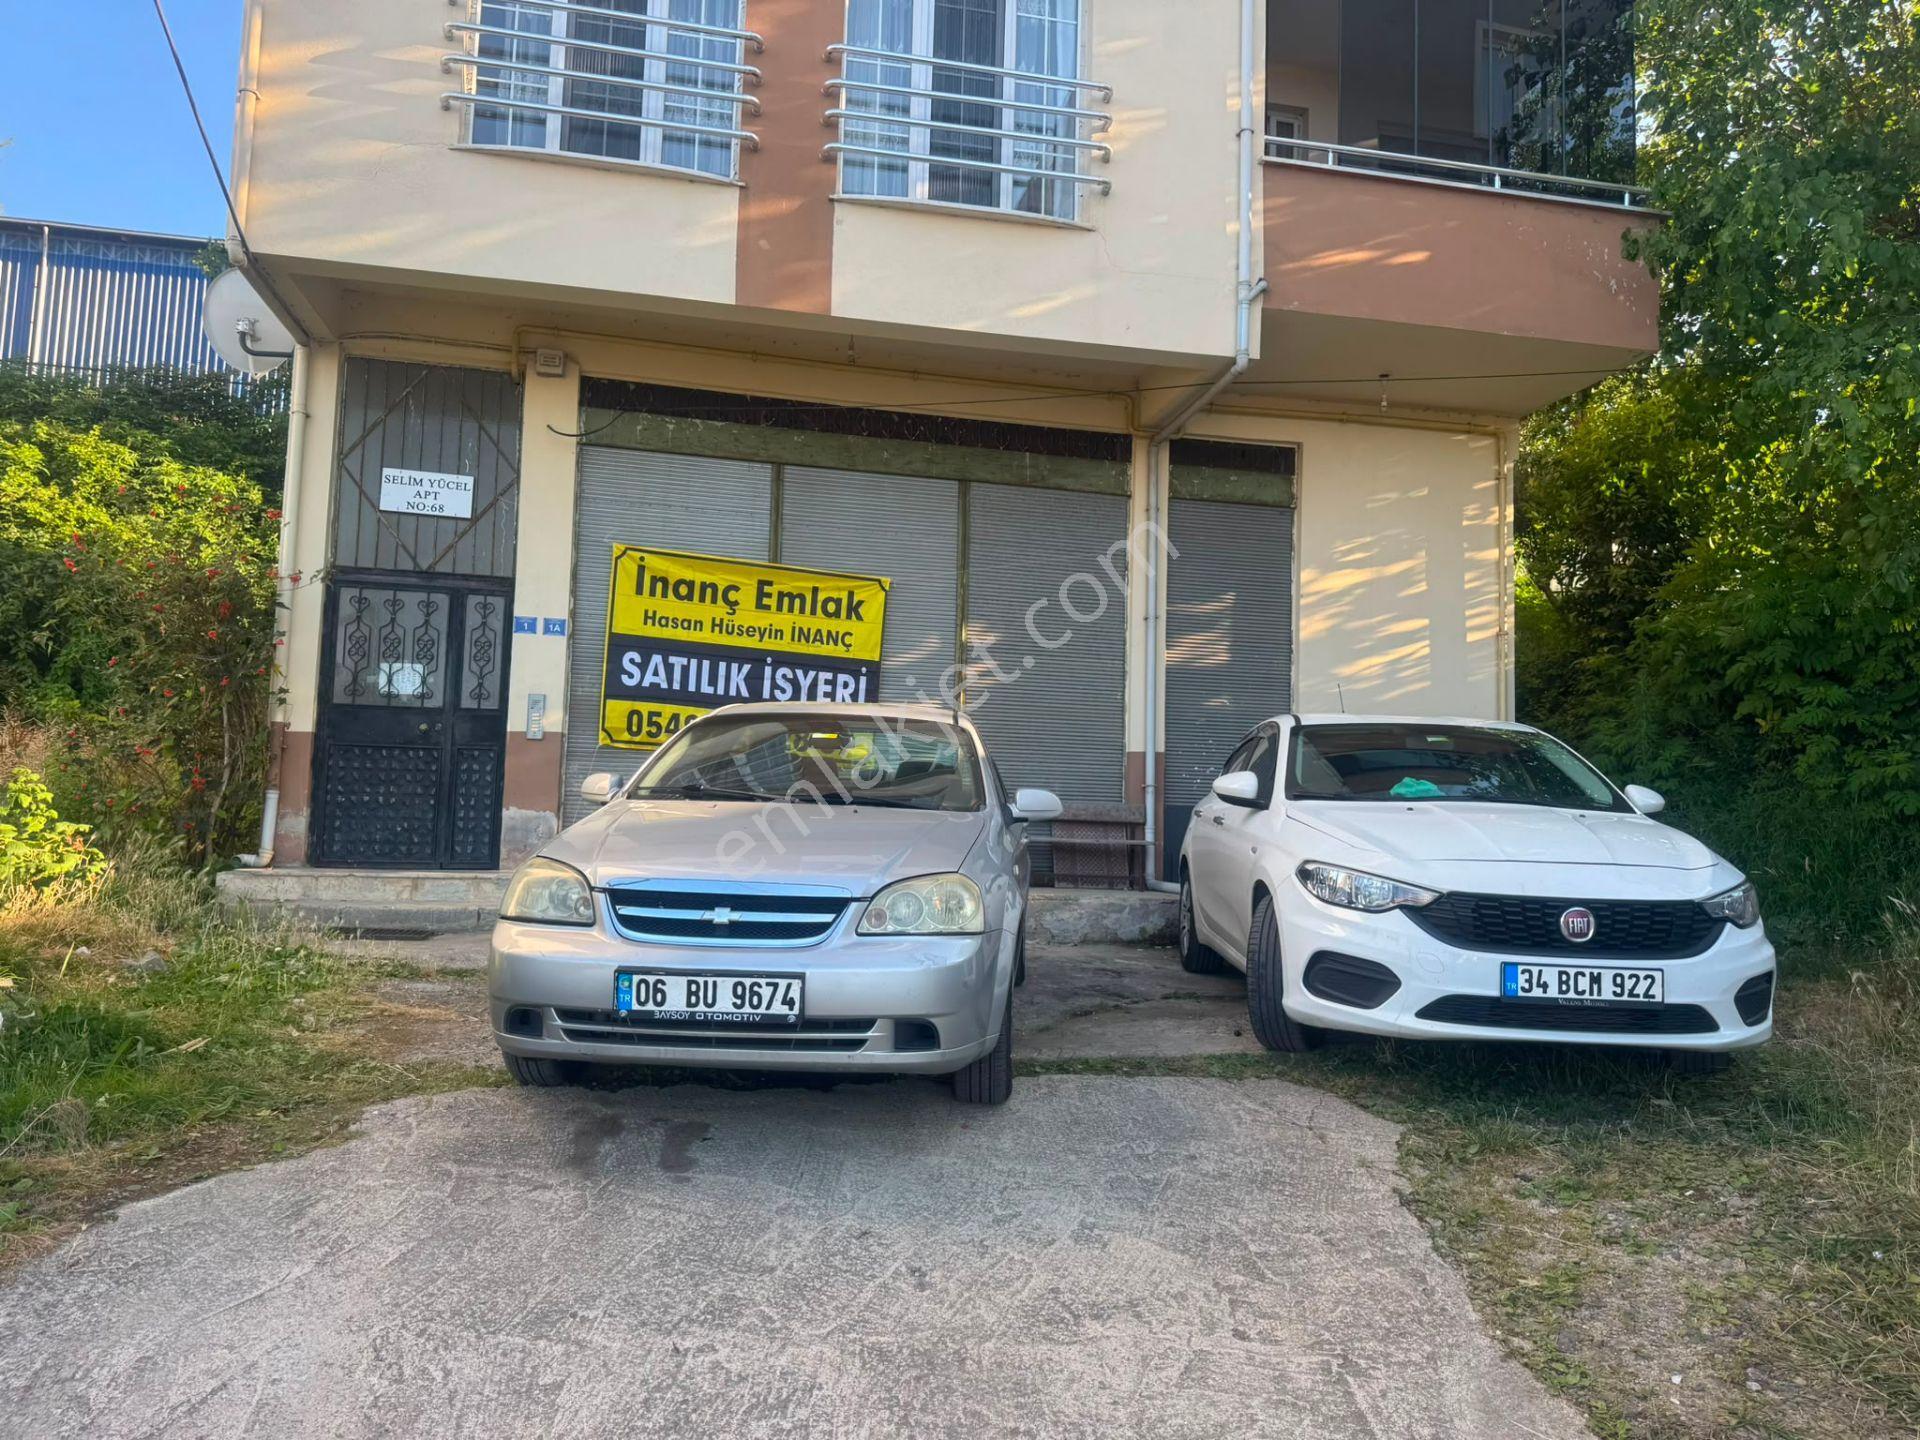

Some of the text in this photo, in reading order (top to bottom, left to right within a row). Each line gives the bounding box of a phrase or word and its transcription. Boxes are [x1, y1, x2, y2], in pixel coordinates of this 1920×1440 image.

[384, 474, 471, 492] SELİM YÜCEL
[406, 501, 445, 513] NO:68
[413, 490, 441, 501] APT
[635, 556, 865, 622] İnanç Emlak
[548, 624, 561, 632] 1A
[643, 609, 854, 652] Hasan Hüseyin İNANÇ
[621, 651, 752, 698] SATILIK
[1568, 917, 1589, 933] FIAT
[620, 978, 797, 1012] TR 06 BU 9674
[1507, 968, 1656, 999] TR 34 BCM 922
